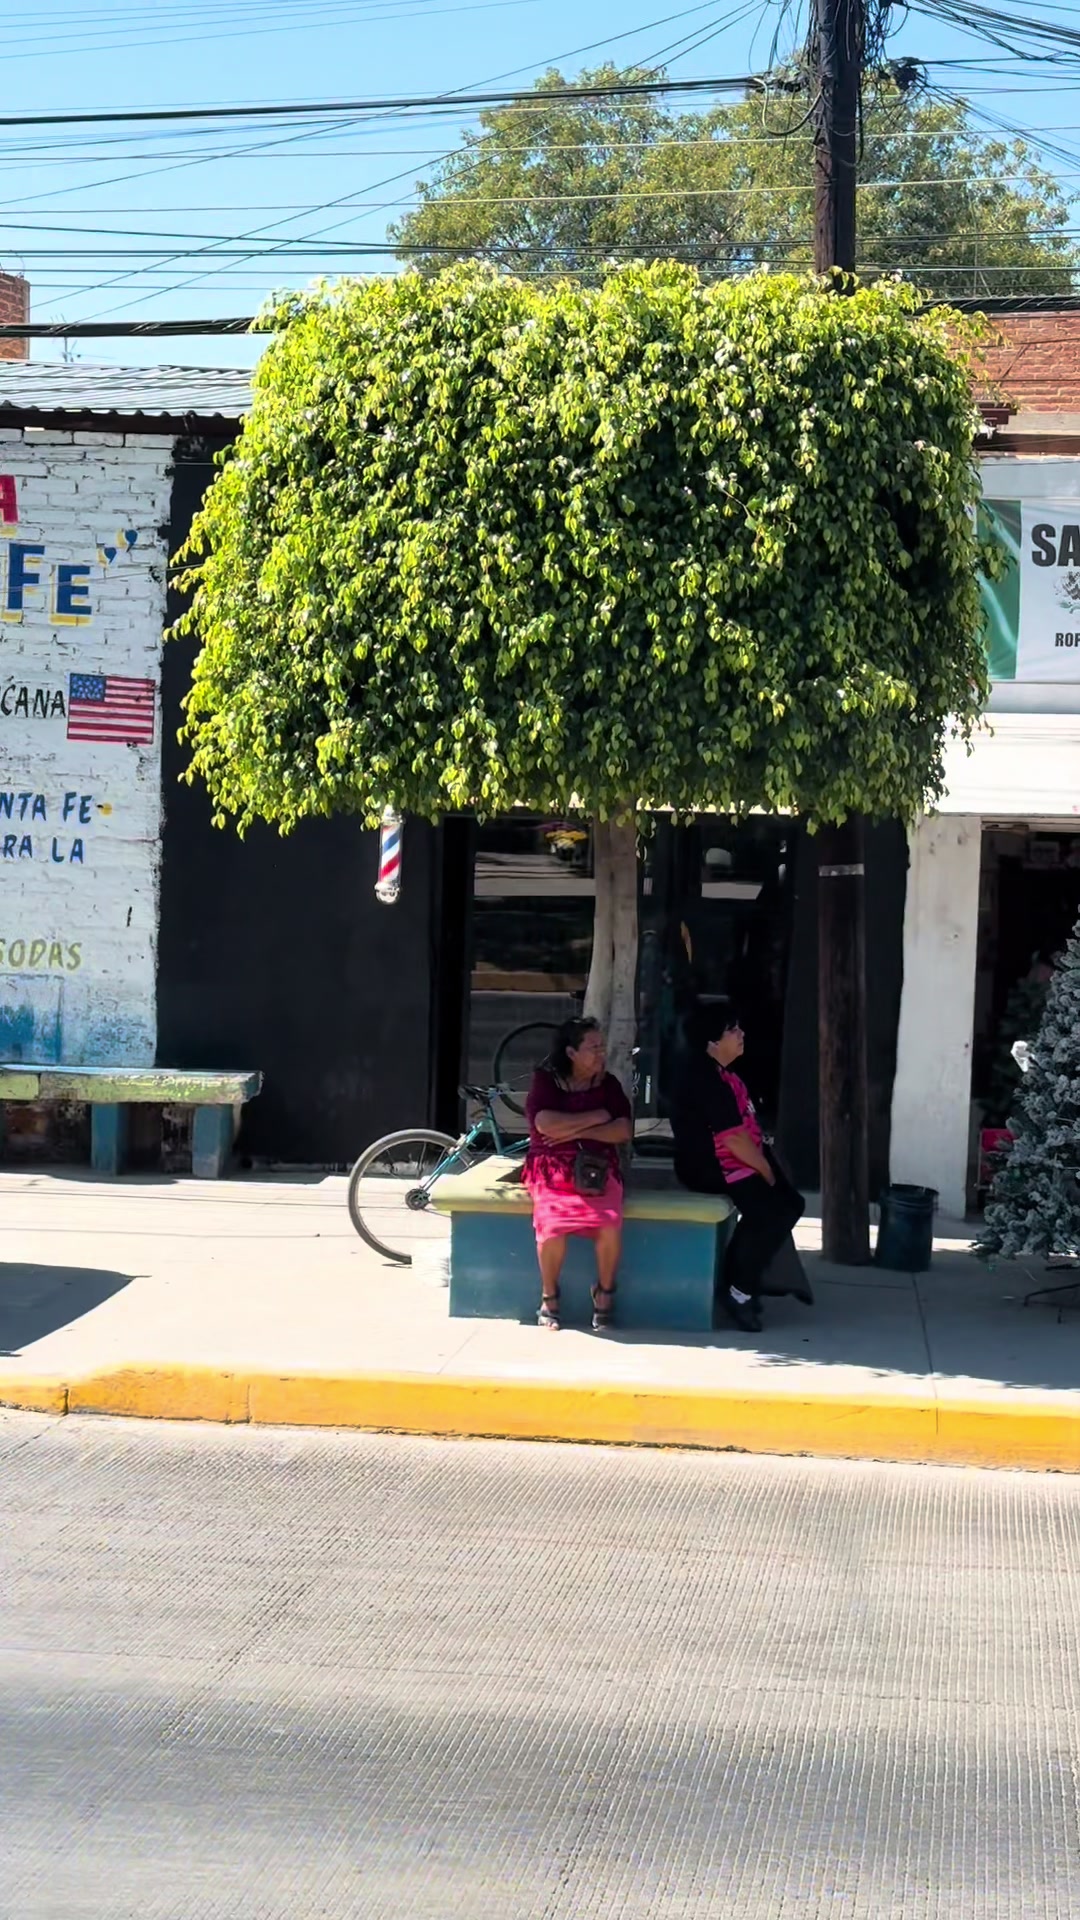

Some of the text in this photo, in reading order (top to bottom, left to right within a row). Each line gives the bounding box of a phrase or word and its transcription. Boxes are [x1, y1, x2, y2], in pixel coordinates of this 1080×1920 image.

[1031, 523, 1080, 567] SA
[0, 684, 66, 718] CANA
[0, 791, 92, 824] NTA FE
[3, 834, 84, 864] RA LA
